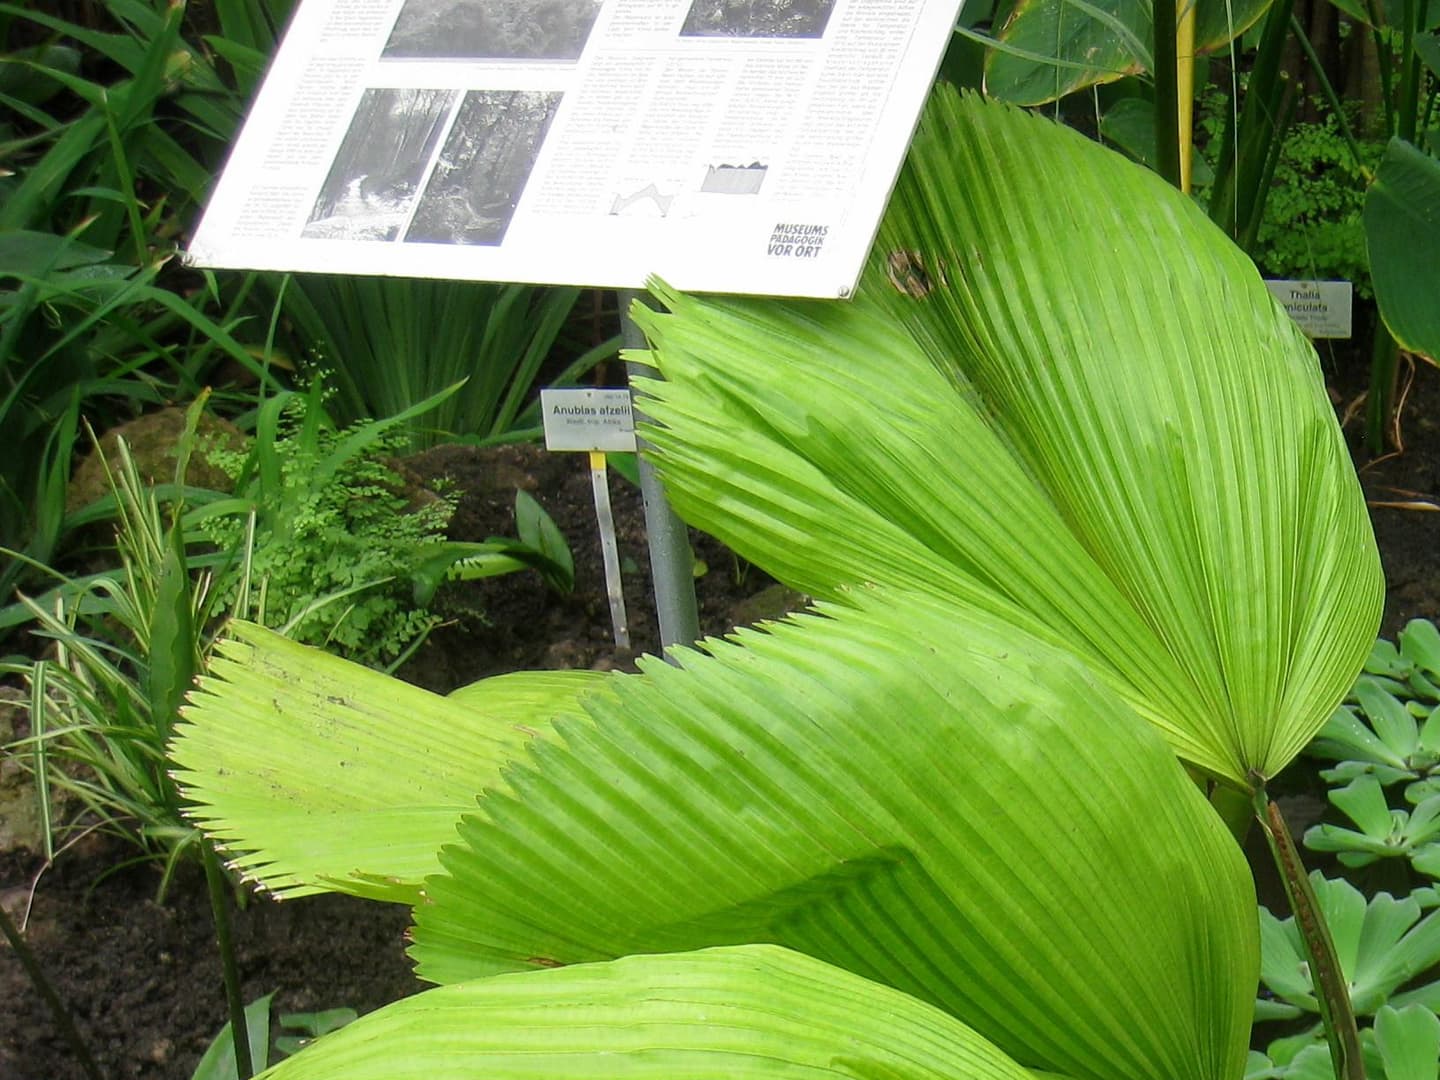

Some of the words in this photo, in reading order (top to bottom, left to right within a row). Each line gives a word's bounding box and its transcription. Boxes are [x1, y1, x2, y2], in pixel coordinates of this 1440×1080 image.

[773, 223, 829, 236] MUSEUMS
[767, 244, 793, 256] VOR
[795, 246, 822, 258] ORT
[1290, 289, 1320, 300] Thalia
[553, 405, 597, 416] Anubias
